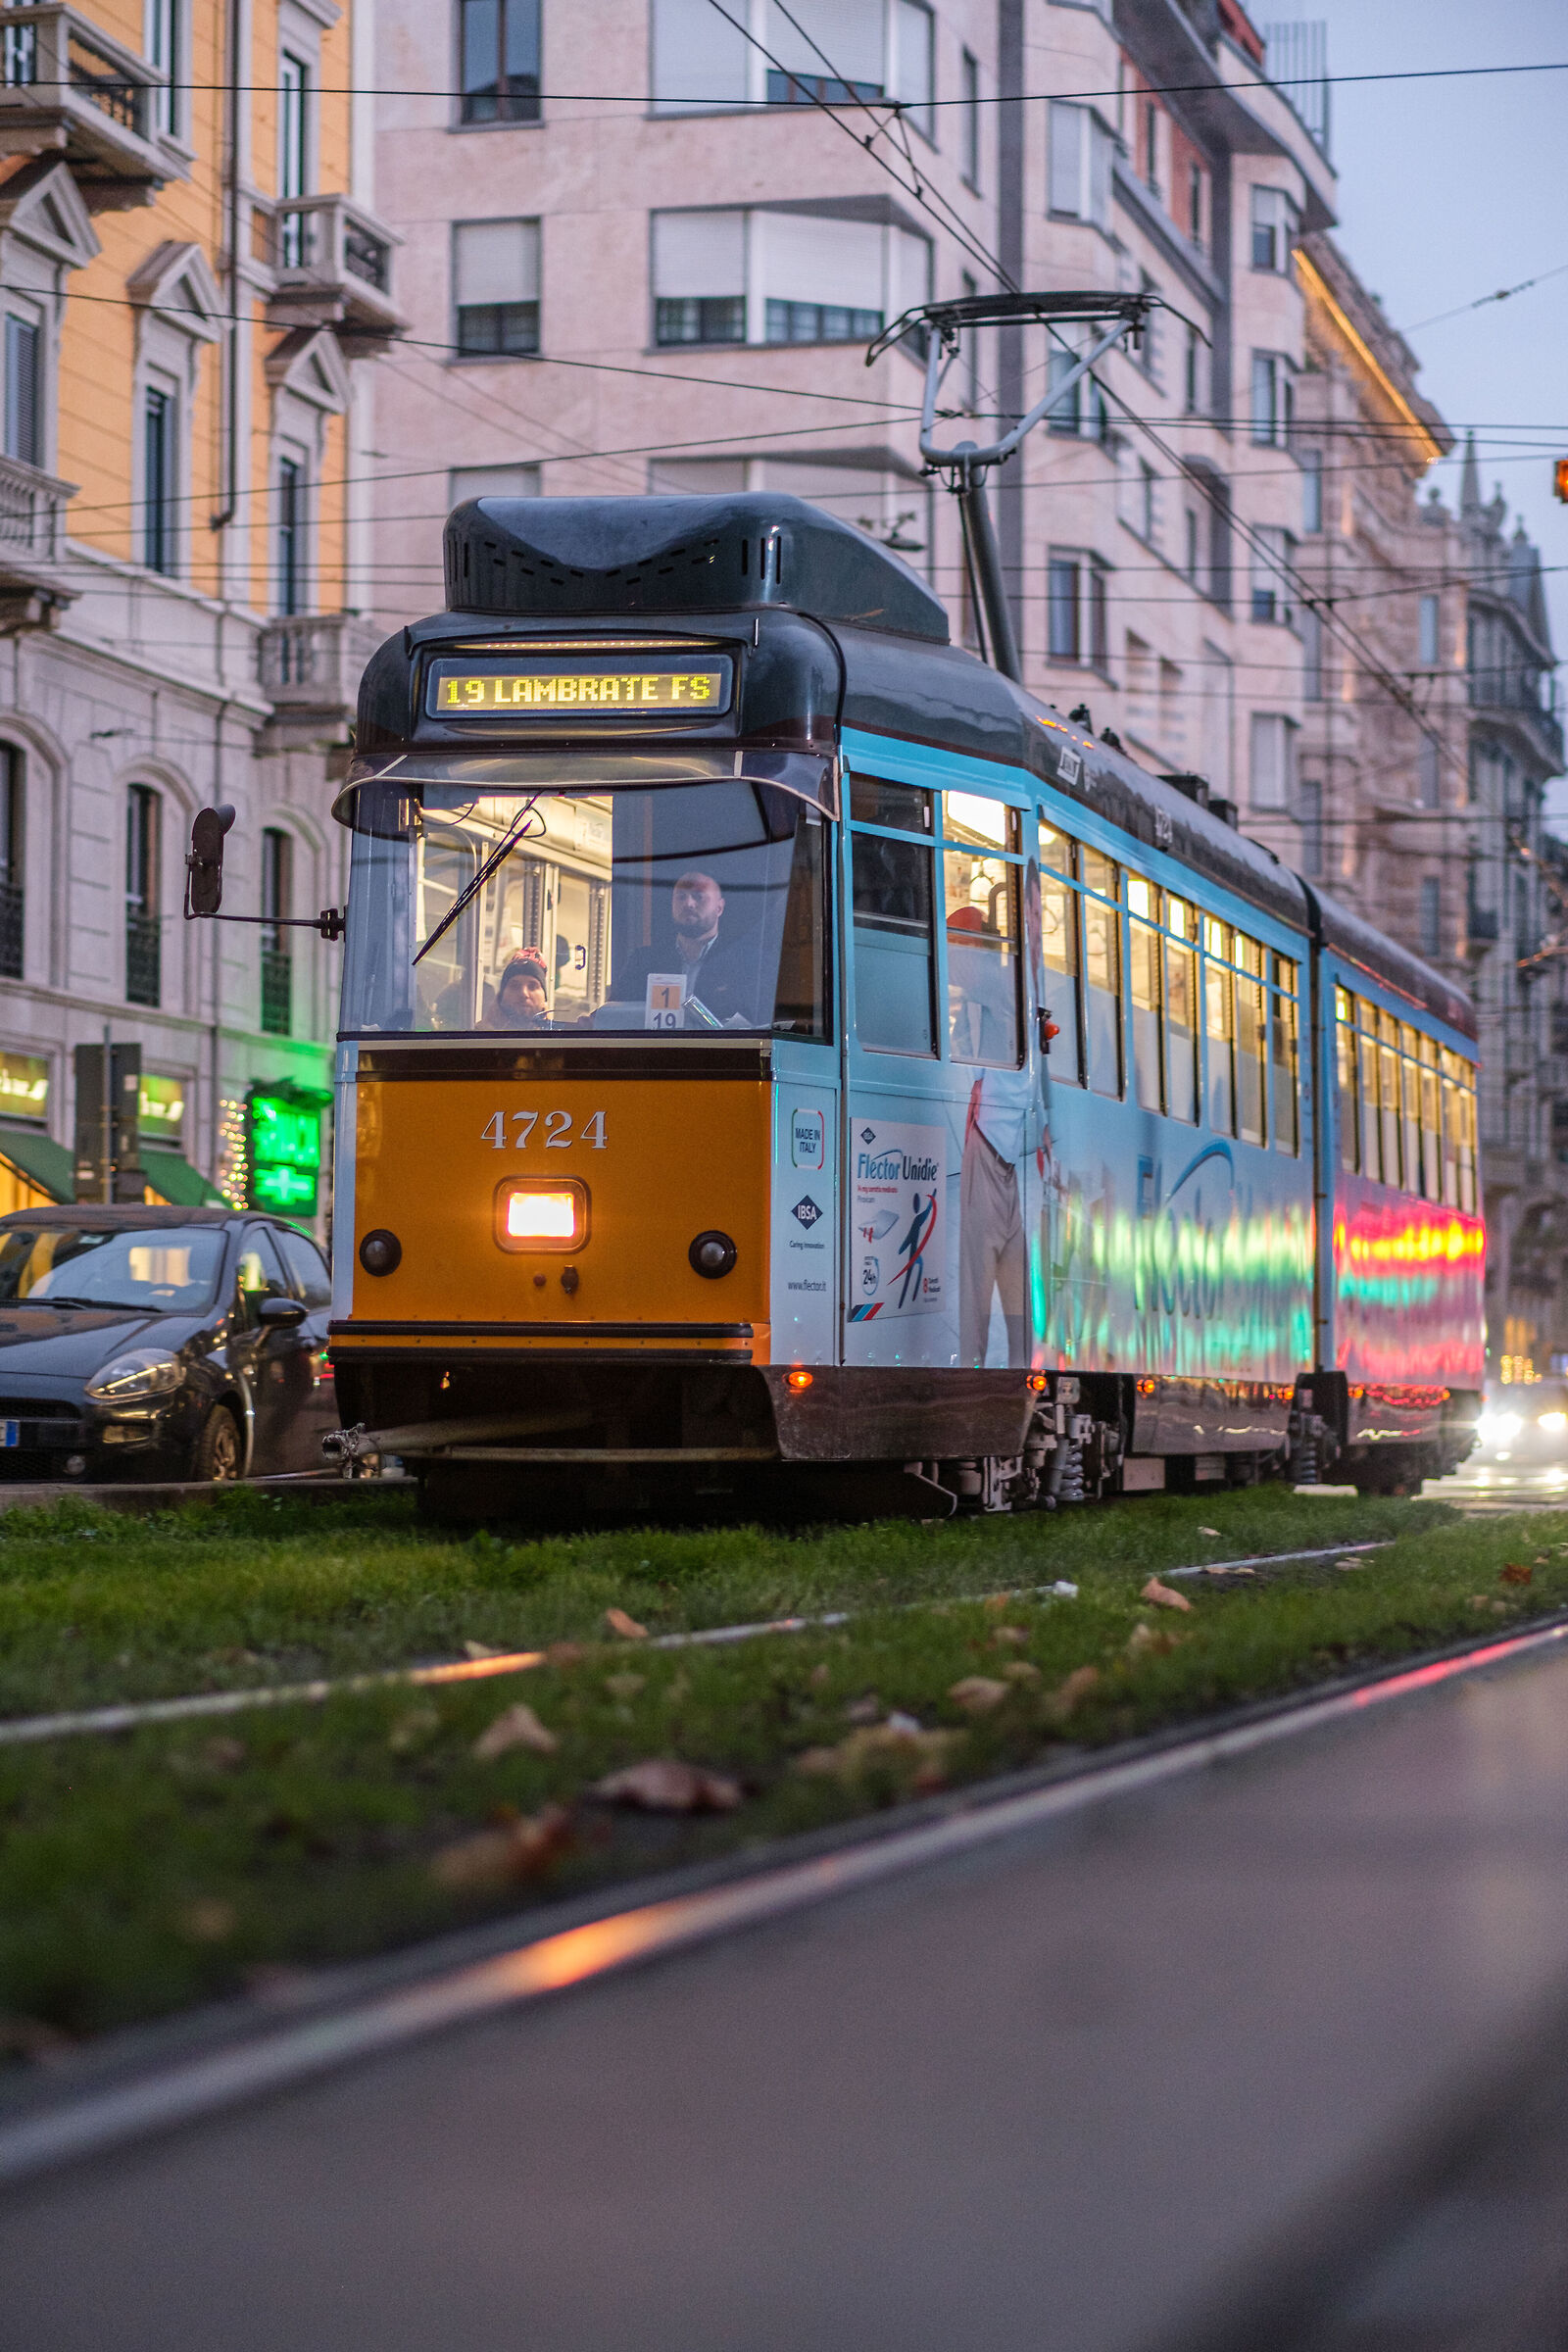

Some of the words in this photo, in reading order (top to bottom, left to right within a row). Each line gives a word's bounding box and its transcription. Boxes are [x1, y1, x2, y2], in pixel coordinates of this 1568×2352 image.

[447, 679, 485, 704] 19
[494, 677, 659, 704] LAMBRATE
[671, 675, 710, 701] FS
[661, 987, 670, 1008] 1
[654, 1012, 676, 1029] 19
[480, 1110, 608, 1150] 4724
[795, 1128, 813, 1140] MADE
[813, 1129, 821, 1141] IN
[799, 1141, 816, 1153] ITALY
[858, 1152, 901, 1180] Flector
[902, 1155, 938, 1181] Unidie
[797, 1204, 817, 1220] IBSA
